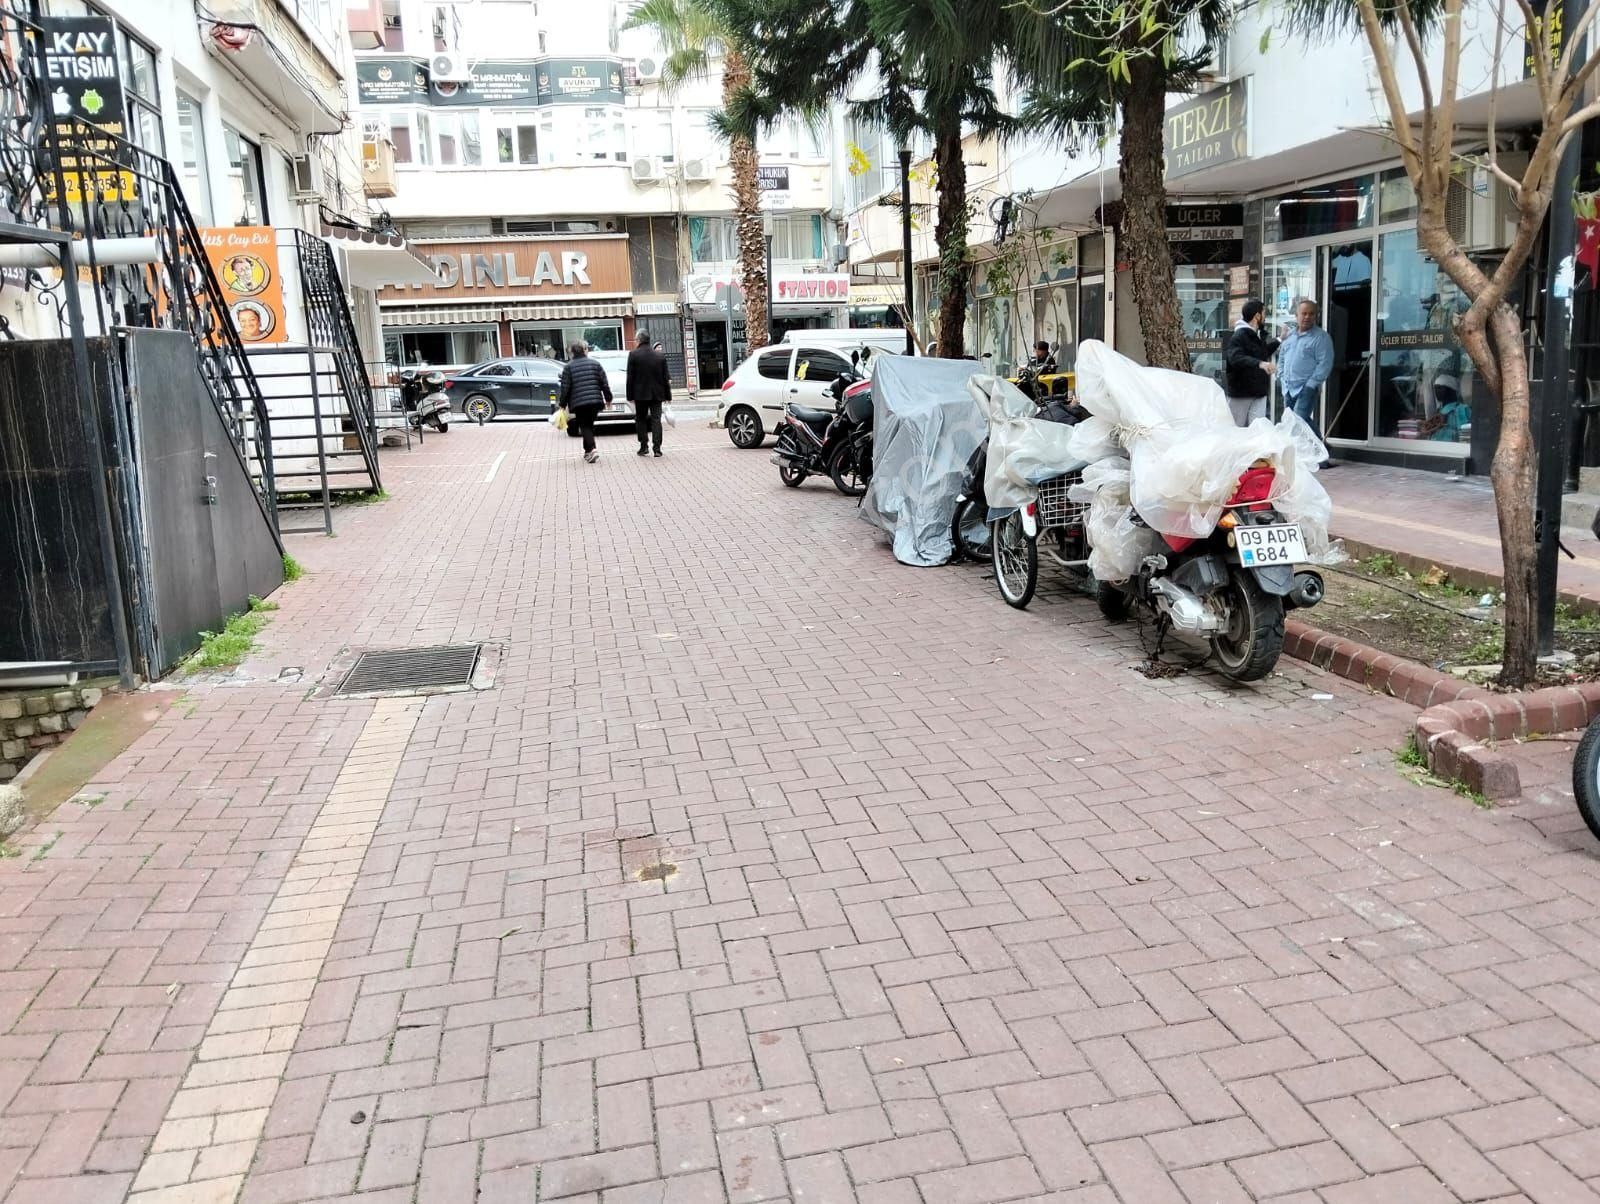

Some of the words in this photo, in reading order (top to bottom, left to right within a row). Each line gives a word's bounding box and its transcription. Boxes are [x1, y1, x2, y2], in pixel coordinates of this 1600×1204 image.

[1168, 85, 1232, 151] TERZİ
[1176, 141, 1221, 168] TAILOR
[1177, 207, 1222, 226] ÜÇLER
[1200, 229, 1234, 239] TAILOR
[375, 251, 592, 291] DINLAR
[778, 280, 848, 298] STATION
[1422, 334, 1444, 345] TAILOR
[1240, 531, 1262, 546] 09
[1267, 528, 1298, 544] ADR
[1256, 545, 1288, 562] 684
